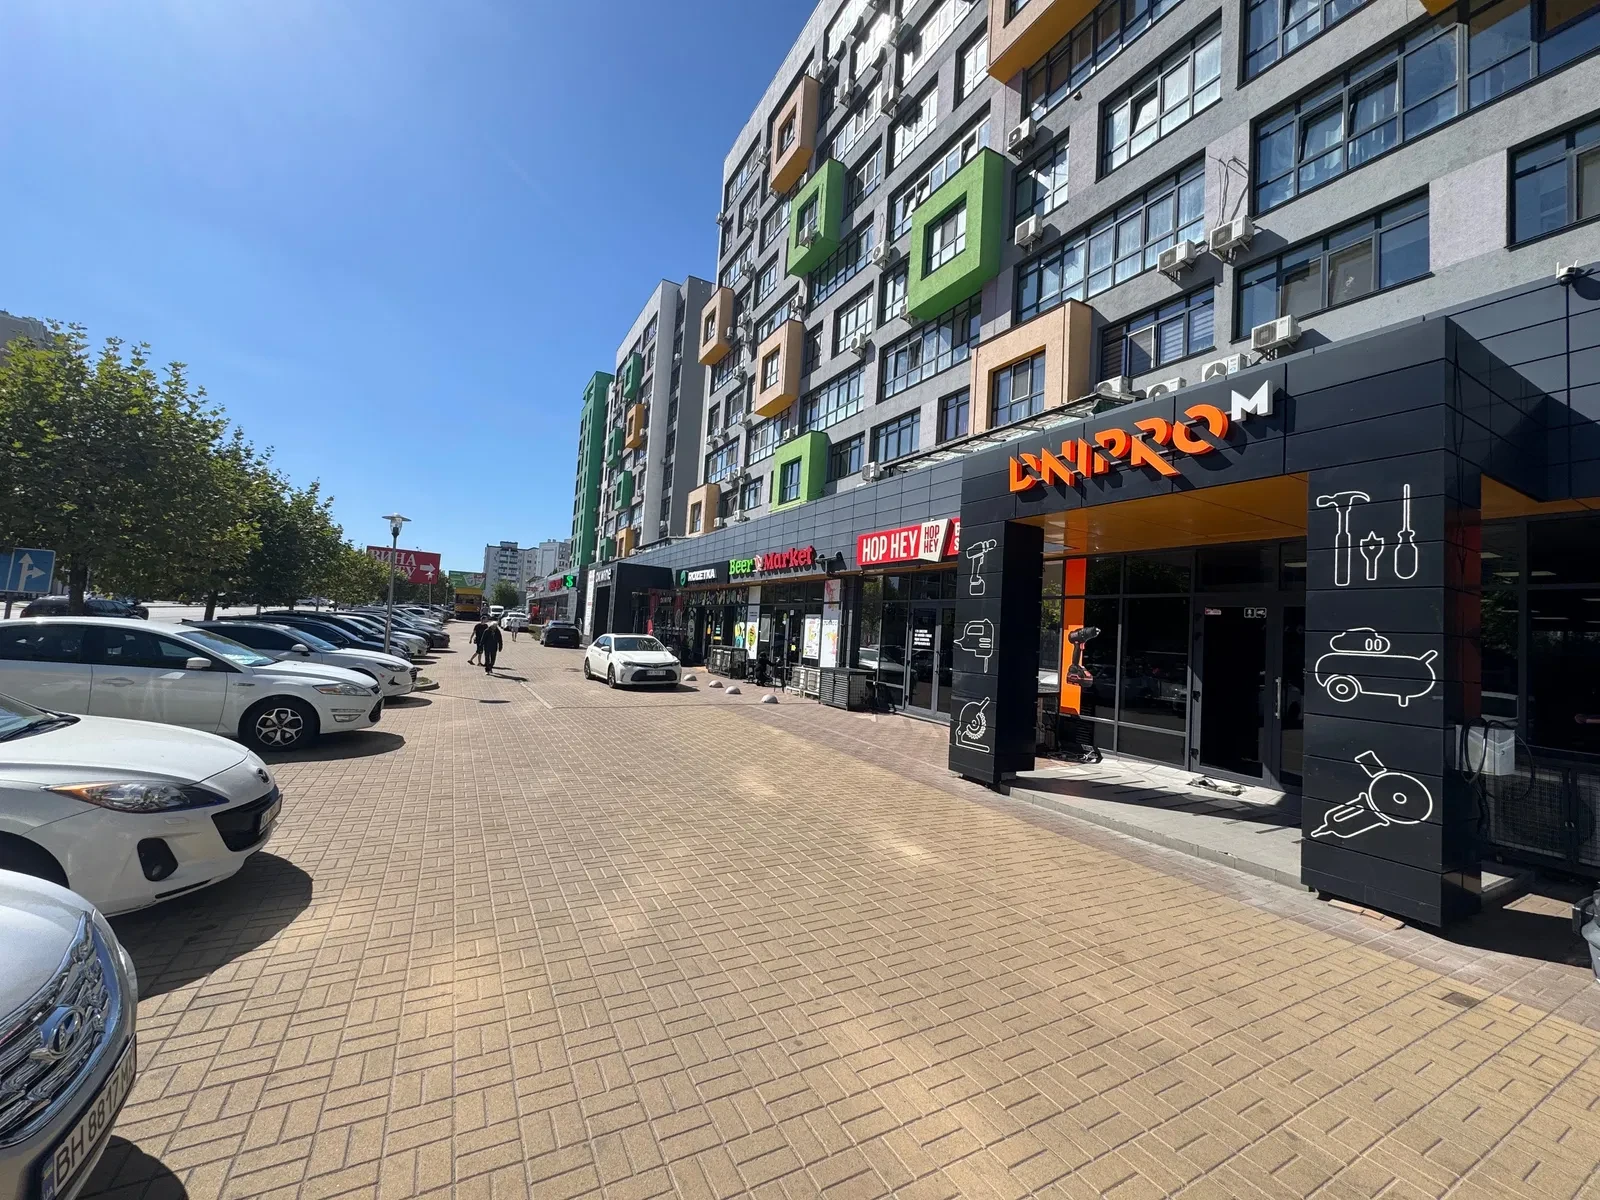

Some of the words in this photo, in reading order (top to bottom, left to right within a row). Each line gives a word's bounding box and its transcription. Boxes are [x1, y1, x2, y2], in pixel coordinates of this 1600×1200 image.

[1009, 404, 1228, 492] DNIPRO
[862, 535, 888, 562] HOP
[890, 529, 918, 559] HEY
[924, 538, 939, 553] HEY
[925, 525, 939, 539] HOP
[687, 568, 715, 582] ROZETKA
[729, 558, 753, 575] Beer
[763, 545, 814, 571] Market
[56, 1125, 84, 1188] BH
[88, 1079, 119, 1140] 8817
